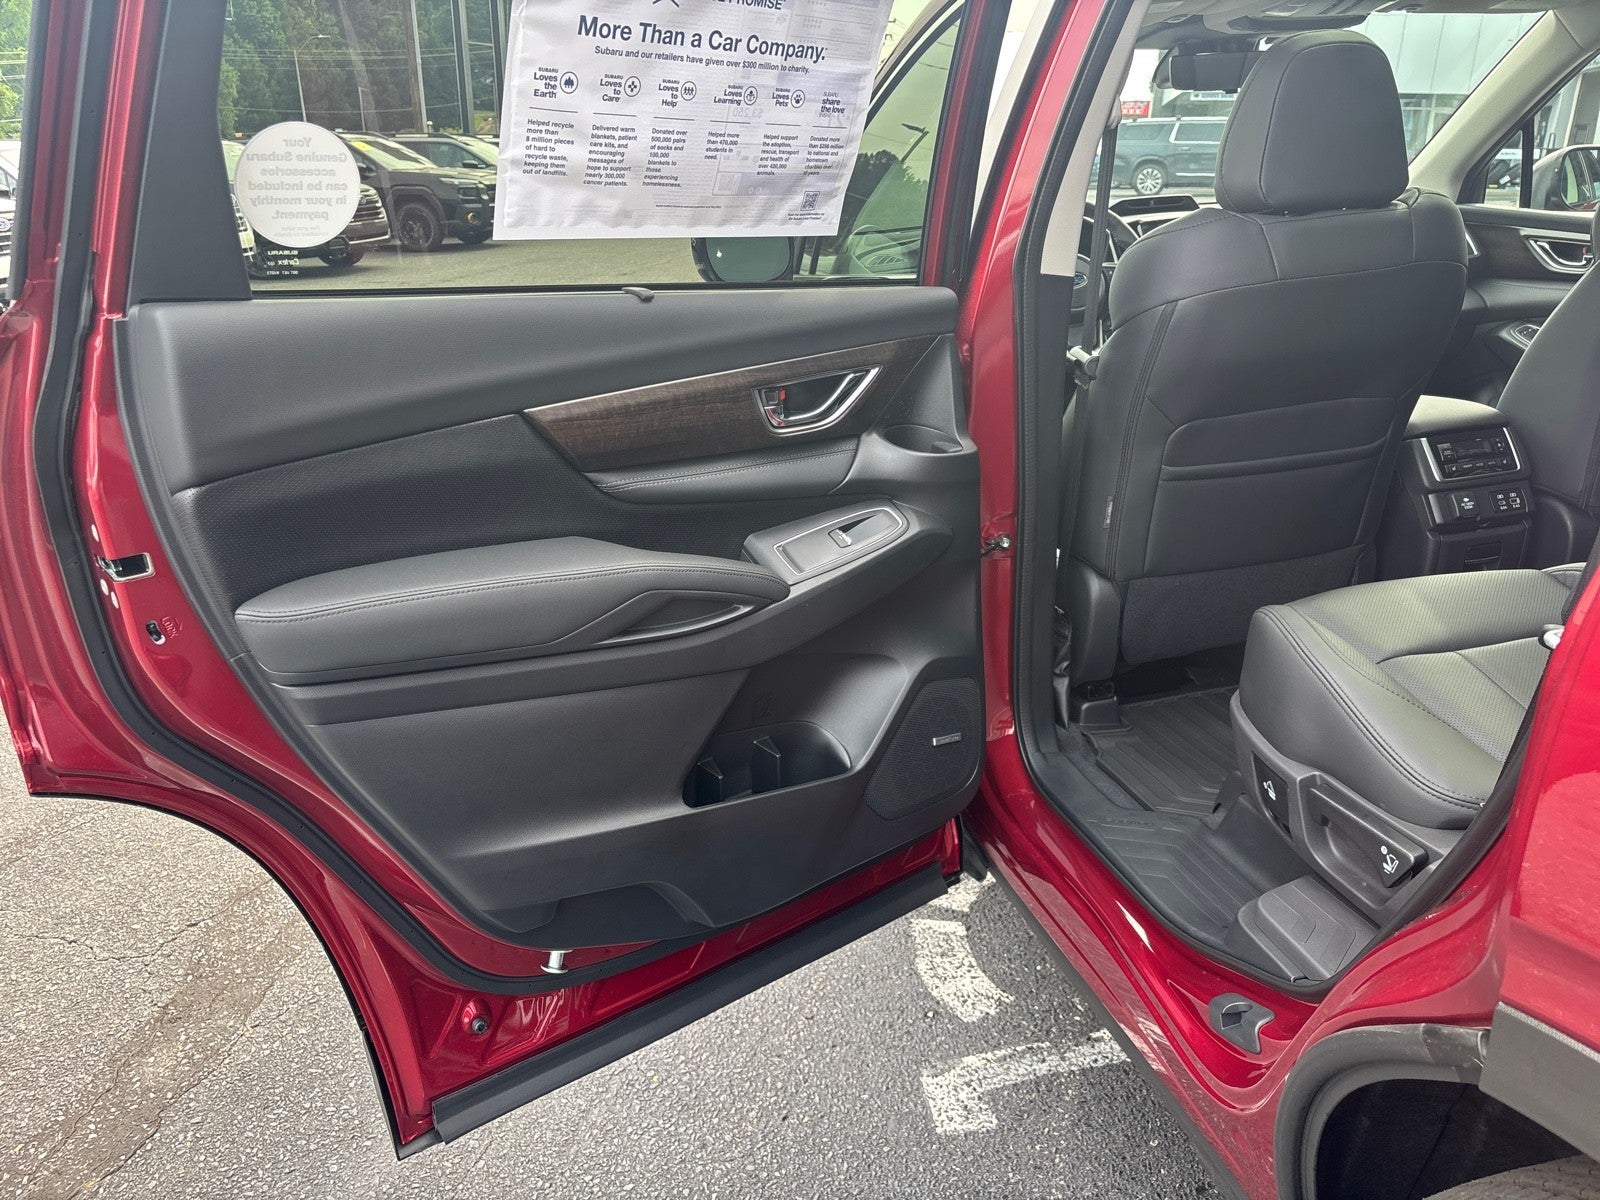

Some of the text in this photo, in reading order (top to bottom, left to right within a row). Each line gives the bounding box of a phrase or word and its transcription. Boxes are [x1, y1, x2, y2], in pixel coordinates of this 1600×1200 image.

[578, 15, 826, 64] More Than a Car Company.
[594, 46, 623, 56] Subaru
[655, 53, 684, 62] retailers
[686, 55, 703, 64] have
[705, 57, 724, 66] given
[742, 60, 757, 69] $300
[758, 62, 779, 70] million
[788, 65, 810, 75] charity.
[534, 72, 558, 81] Loves
[544, 82, 557, 90] the
[600, 79, 622, 88] Loves
[658, 84, 679, 92] Loves
[534, 89, 557, 98] Earth
[724, 89, 742, 97] Loves
[602, 94, 620, 102] Care
[714, 96, 741, 106] Learning
[662, 99, 677, 108] Help
[831, 106, 845, 114] love
[527, 119, 574, 130] Helped recycle
[525, 153, 547, 162] recycle
[524, 160, 548, 169] keeping
